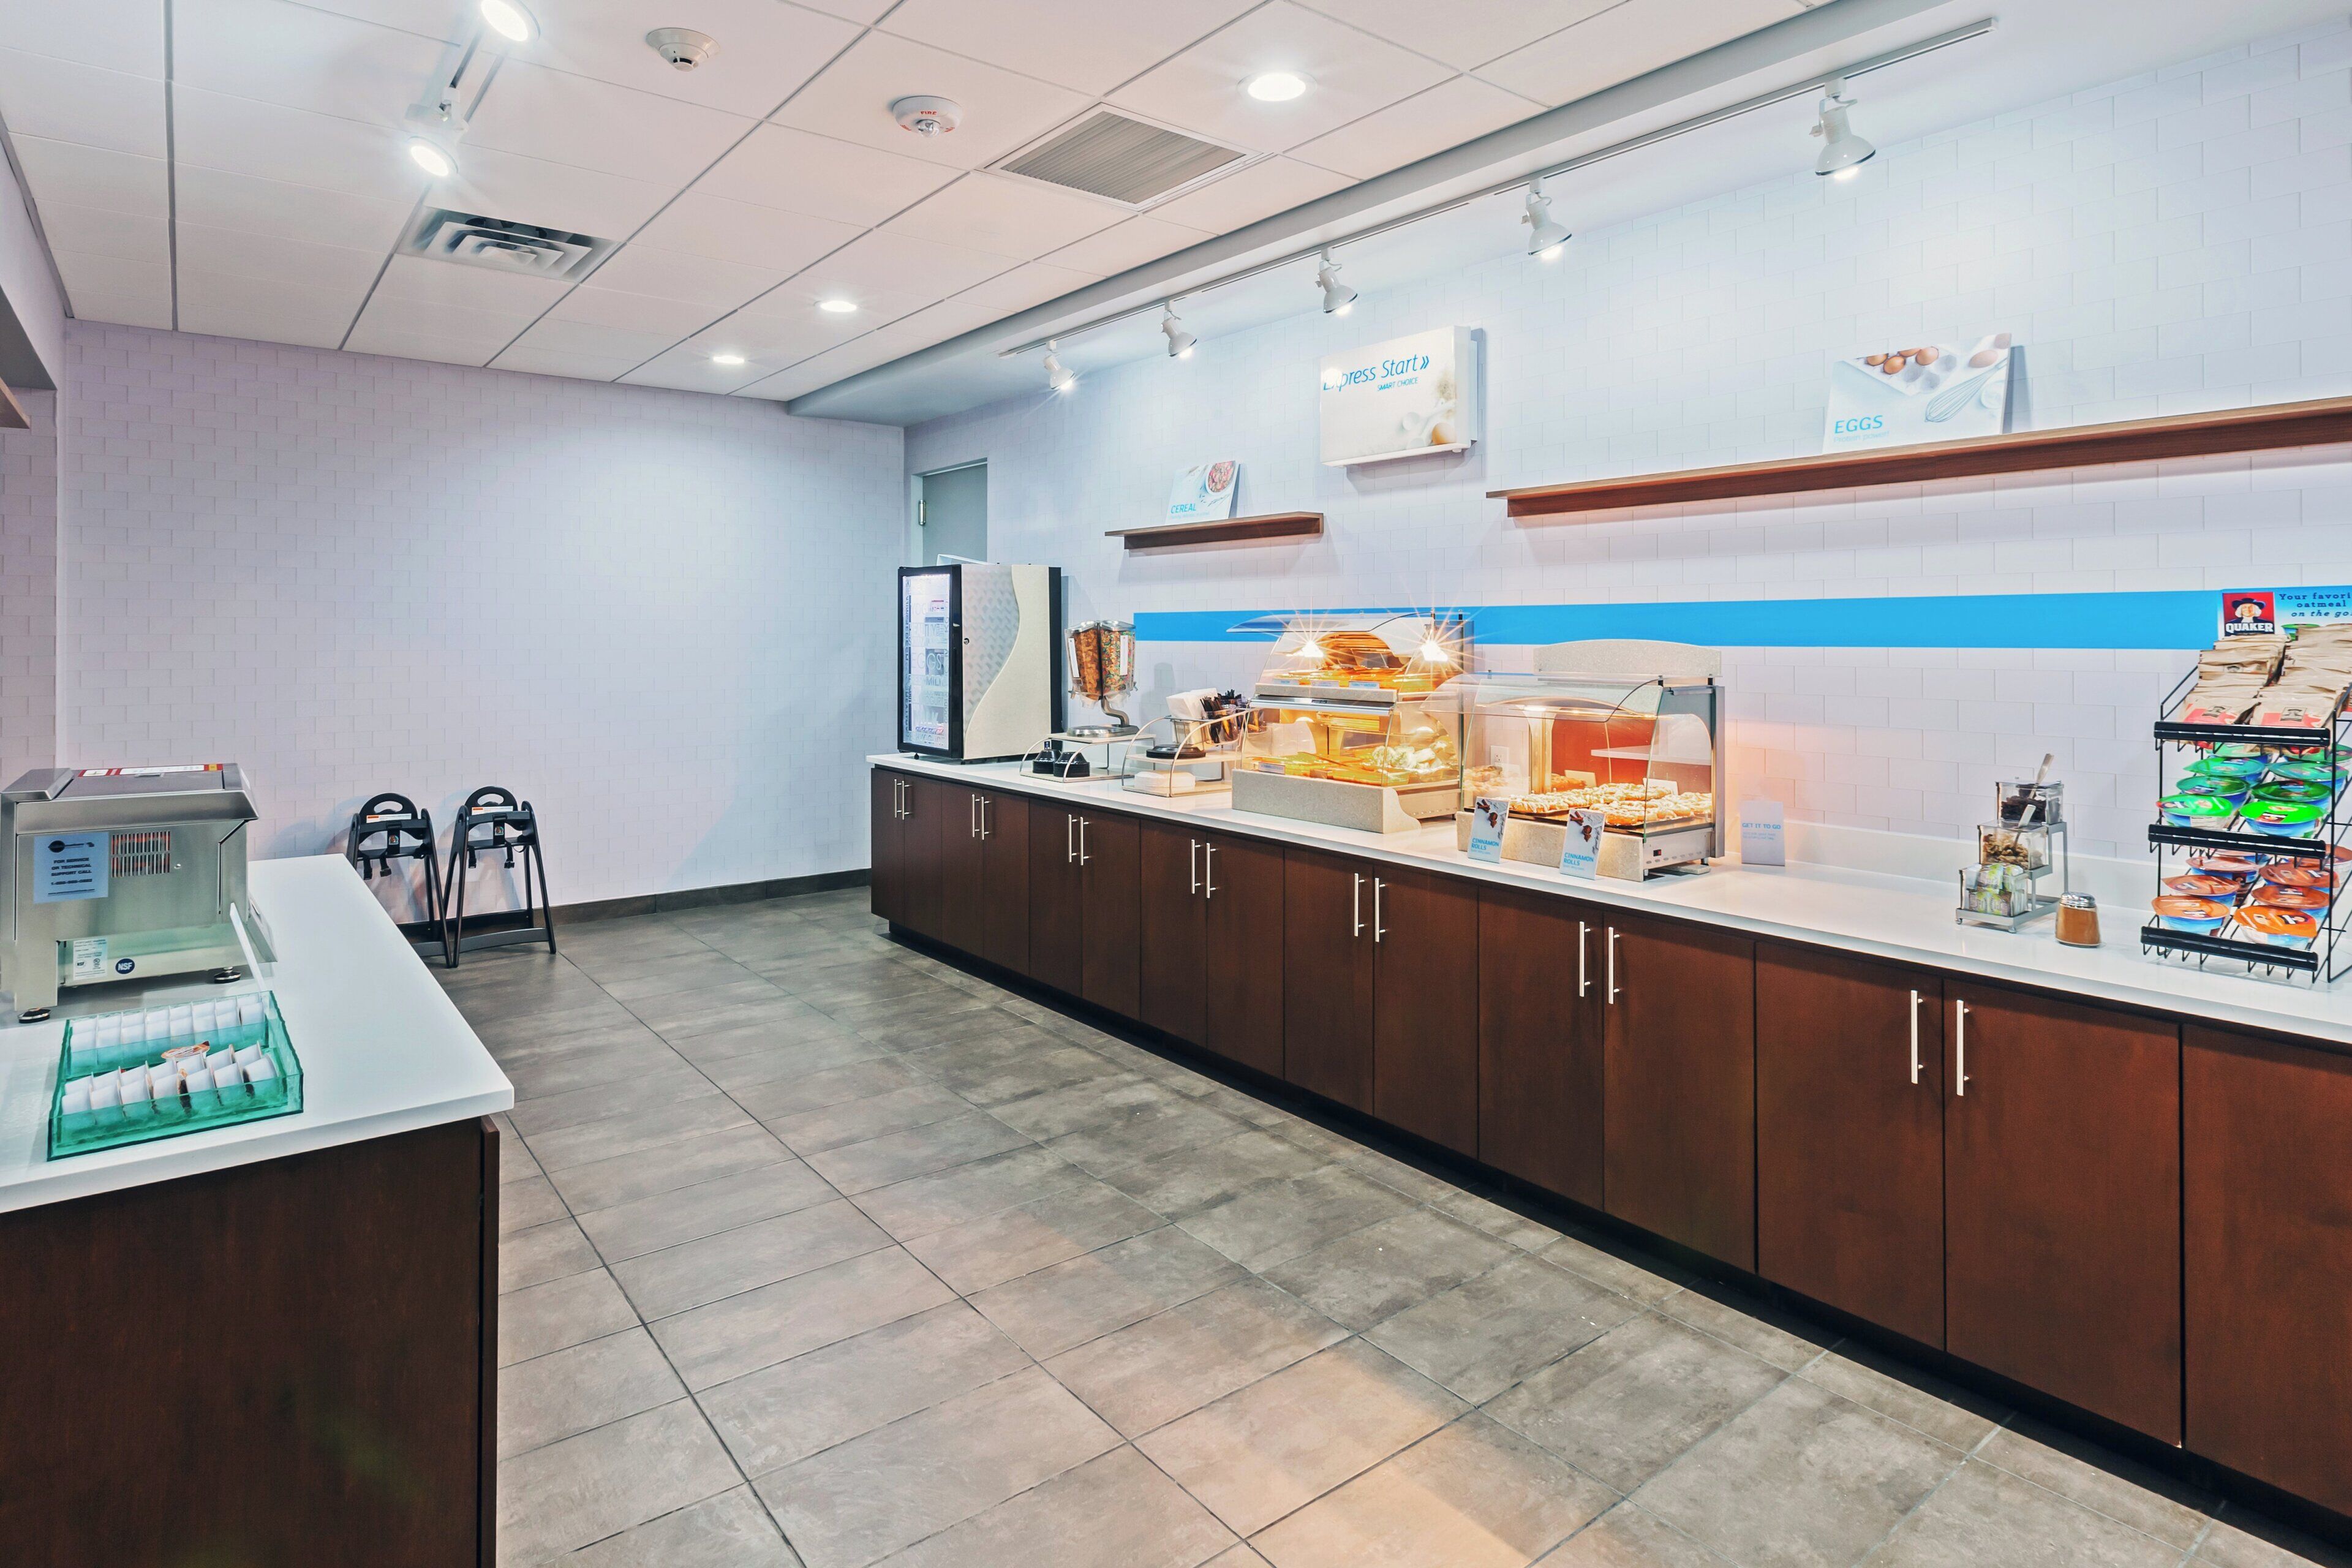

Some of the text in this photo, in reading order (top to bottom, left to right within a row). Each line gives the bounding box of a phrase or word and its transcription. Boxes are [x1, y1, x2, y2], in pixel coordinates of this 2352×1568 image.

[1381, 354, 1419, 379] Start
[1377, 377, 1419, 392] SMART CHOICE
[1834, 415, 1883, 434] EGGS
[1170, 503, 1197, 514] CEREAL
[2296, 599, 2346, 608] oatmeal
[2225, 622, 2275, 633] QUAKER
[1472, 837, 1499, 847] CINNAMON
[1564, 852, 1594, 862] CINNAMON
[118, 962, 133, 971] NSF
